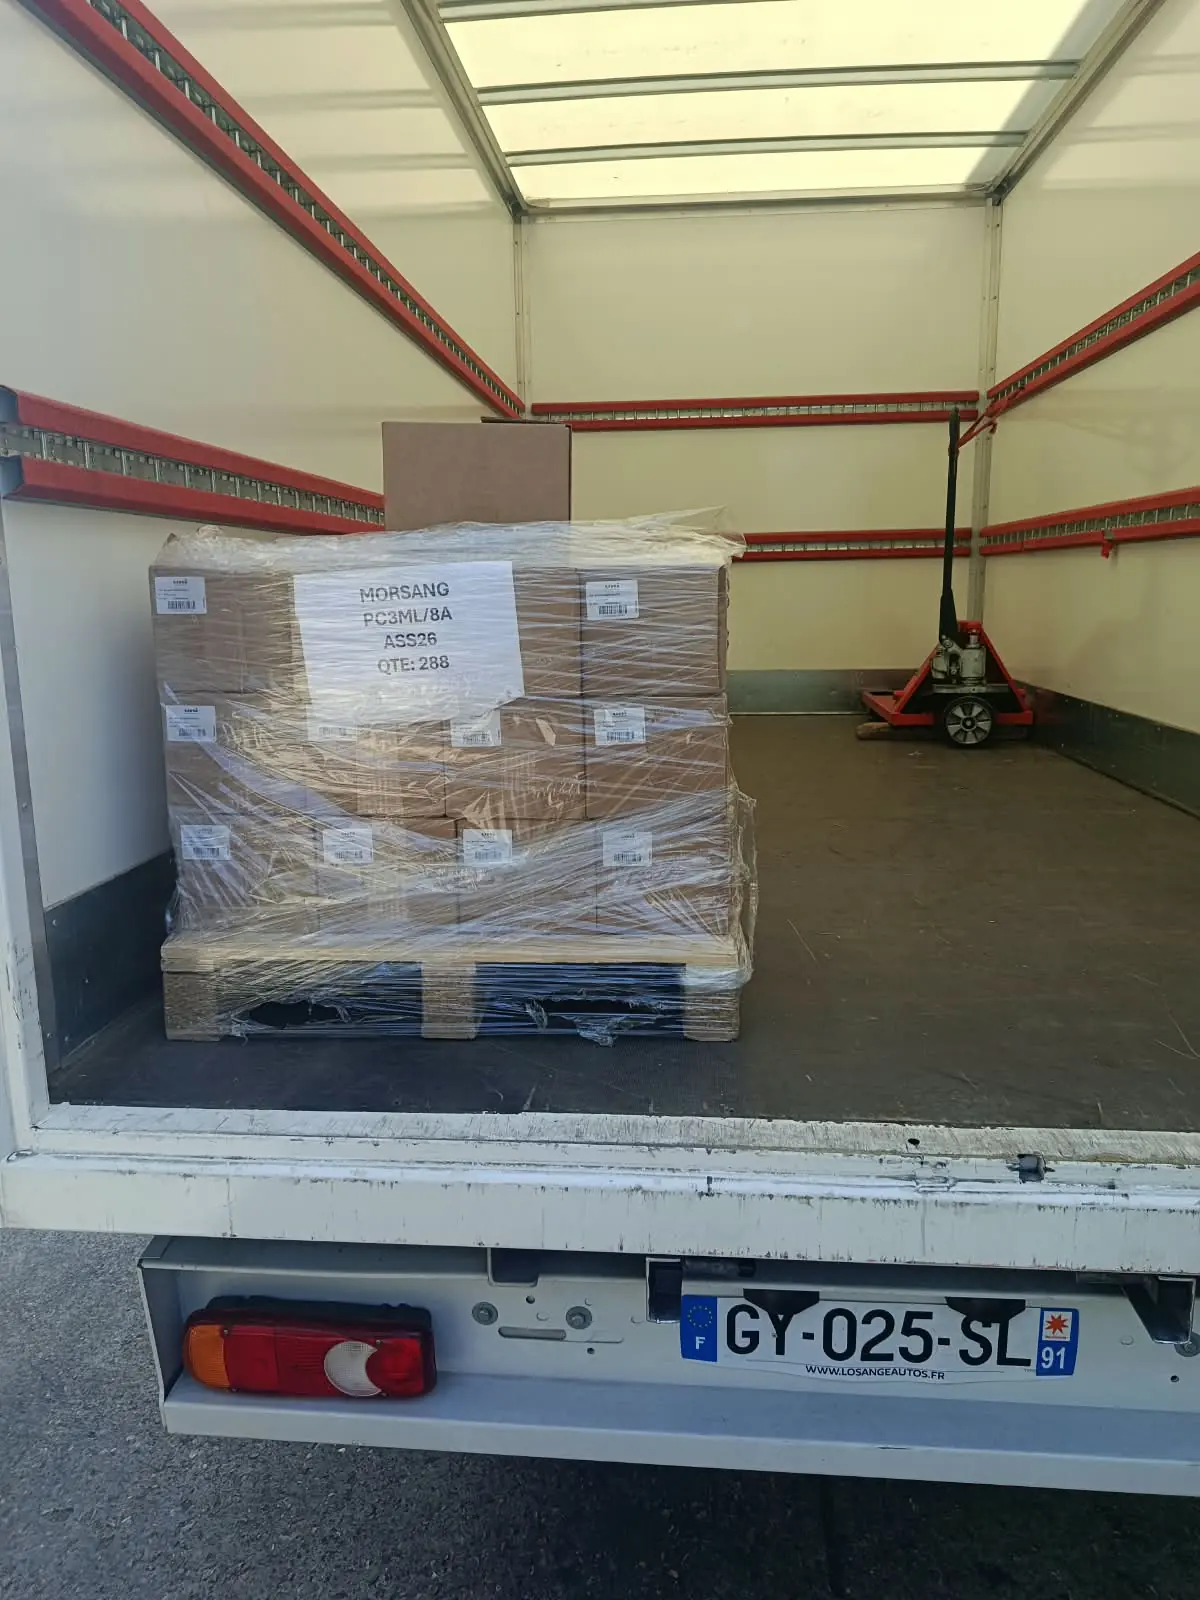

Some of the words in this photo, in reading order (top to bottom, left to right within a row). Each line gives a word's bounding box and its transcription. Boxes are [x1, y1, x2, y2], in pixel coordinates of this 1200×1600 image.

[359, 582, 450, 603] MORSANG
[363, 606, 453, 627] PC3ML/8A
[384, 632, 437, 649] ASS26
[377, 658, 415, 675] QTE:
[418, 655, 450, 671] 288
[694, 1335, 706, 1351] F
[726, 1303, 1032, 1367] GY-025-SL
[1041, 1346, 1066, 1370] 91
[805, 1364, 945, 1381] WWW.LOSANGEAUTOS.FR
